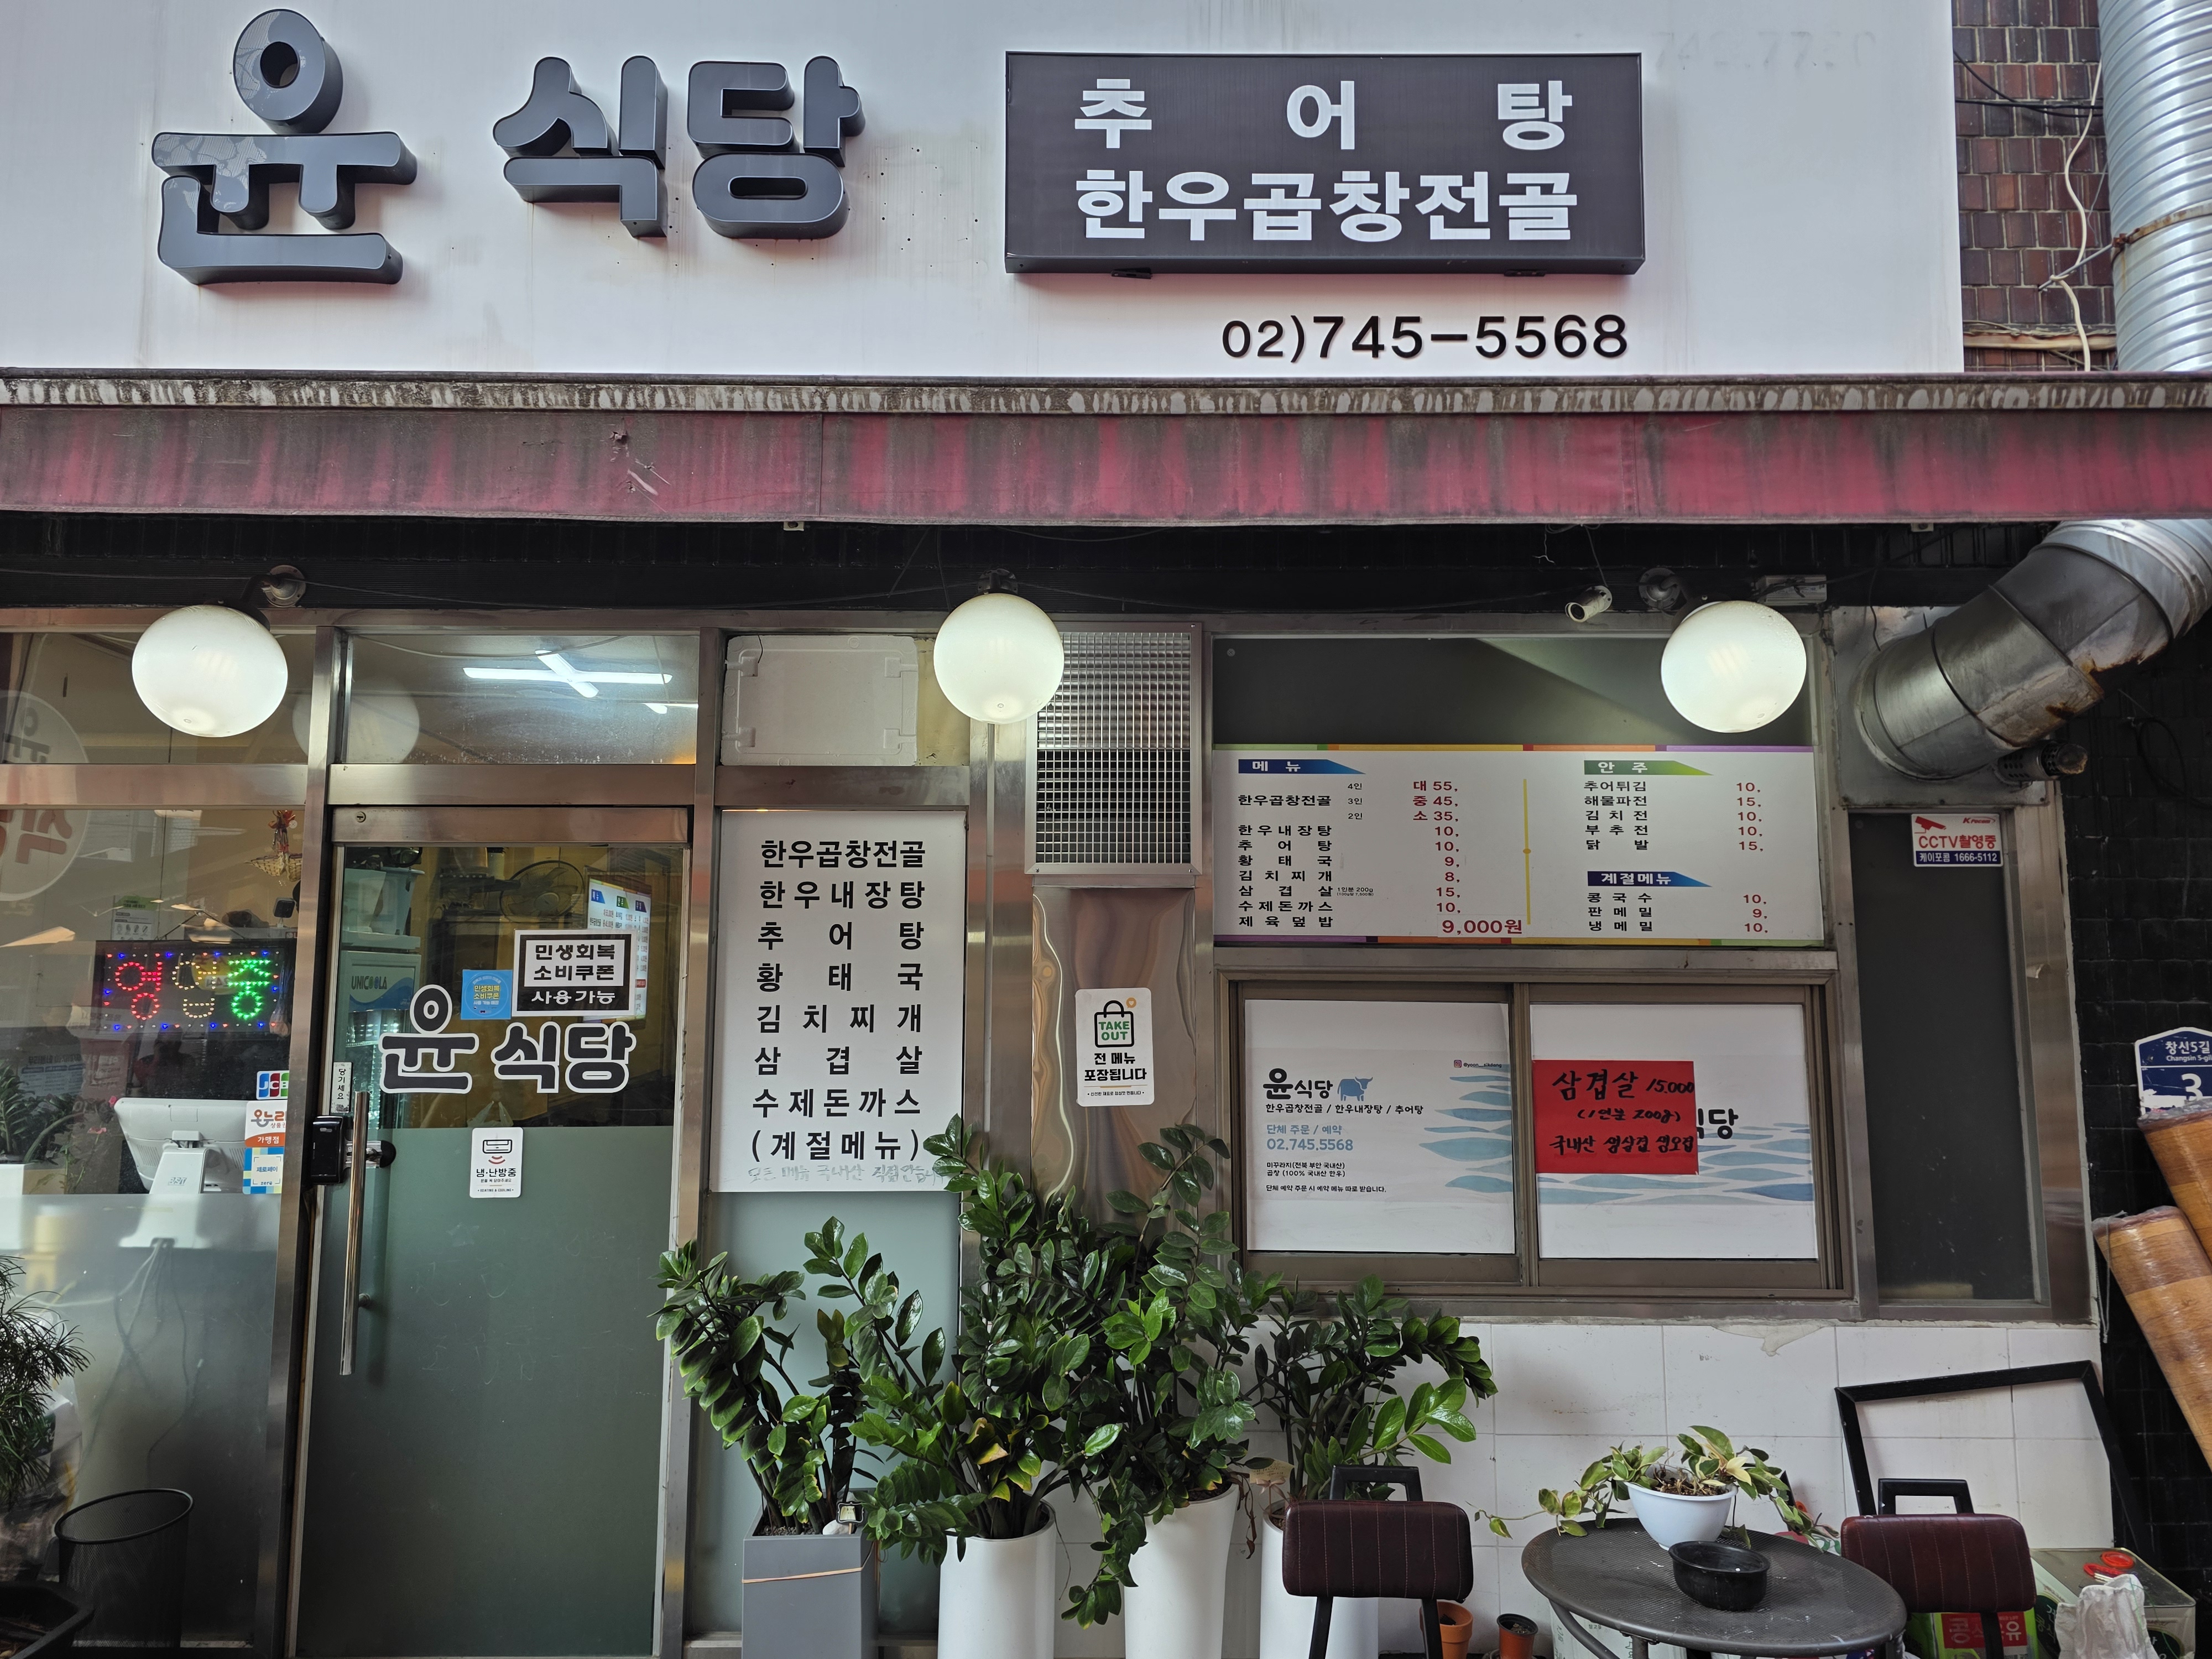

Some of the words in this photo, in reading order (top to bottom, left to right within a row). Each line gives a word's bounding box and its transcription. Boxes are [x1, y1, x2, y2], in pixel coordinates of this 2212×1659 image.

[152, 8, 416, 285] 윤
[493, 56, 864, 238] 식당
[1076, 170, 1577, 242] 한우곱창전골
[1223, 315, 1627, 363] 02)745-5568
[1413, 781, 1426, 791] 대
[1584, 781, 1646, 791] 추어튀김
[1238, 795, 1331, 806] 한우곱창전골
[1413, 796, 1427, 806] 중
[1584, 796, 1647, 806] 해물파전
[1413, 811, 1427, 820] 소
[1918, 834, 1996, 849] CCTV촬영중
[761, 841, 925, 868] 한우곱창전골
[1954, 853, 1997, 862] 1666-5112
[1601, 873, 1672, 885] 계절메뉴
[1443, 920, 1522, 935] 9,000원
[536, 944, 615, 961] 민생회복
[534, 966, 614, 980] 소비쿠폰
[115, 960, 271, 1020] 영업중
[1098, 1021, 1130, 1030] TAKE
[1101, 1031, 1128, 1041] OUT
[2165, 1041, 2210, 1055] 창신5길
[1094, 1052, 1106, 1065] 전
[1111, 1052, 1136, 1065] 메뉴
[1084, 1068, 1147, 1081] 포장됩니다
[259, 1081, 289, 1089] JCB
[338, 1068, 346, 1099] 당기세요
[1263, 1068, 1333, 1099] 윤식당
[1552, 1068, 1639, 1101] 삼겹살
[2181, 1073, 2203, 1101] 3
[1266, 1104, 1322, 1113] 한우곱창전골
[1335, 1104, 1383, 1114] 한우내장탕
[1395, 1105, 1423, 1114] 추어탕
[1266, 1125, 1286, 1135] 단체
[1290, 1125, 1310, 1135] 주문
[1322, 1125, 1343, 1135] 예약
[1267, 1139, 1353, 1151] 02.745.5568
